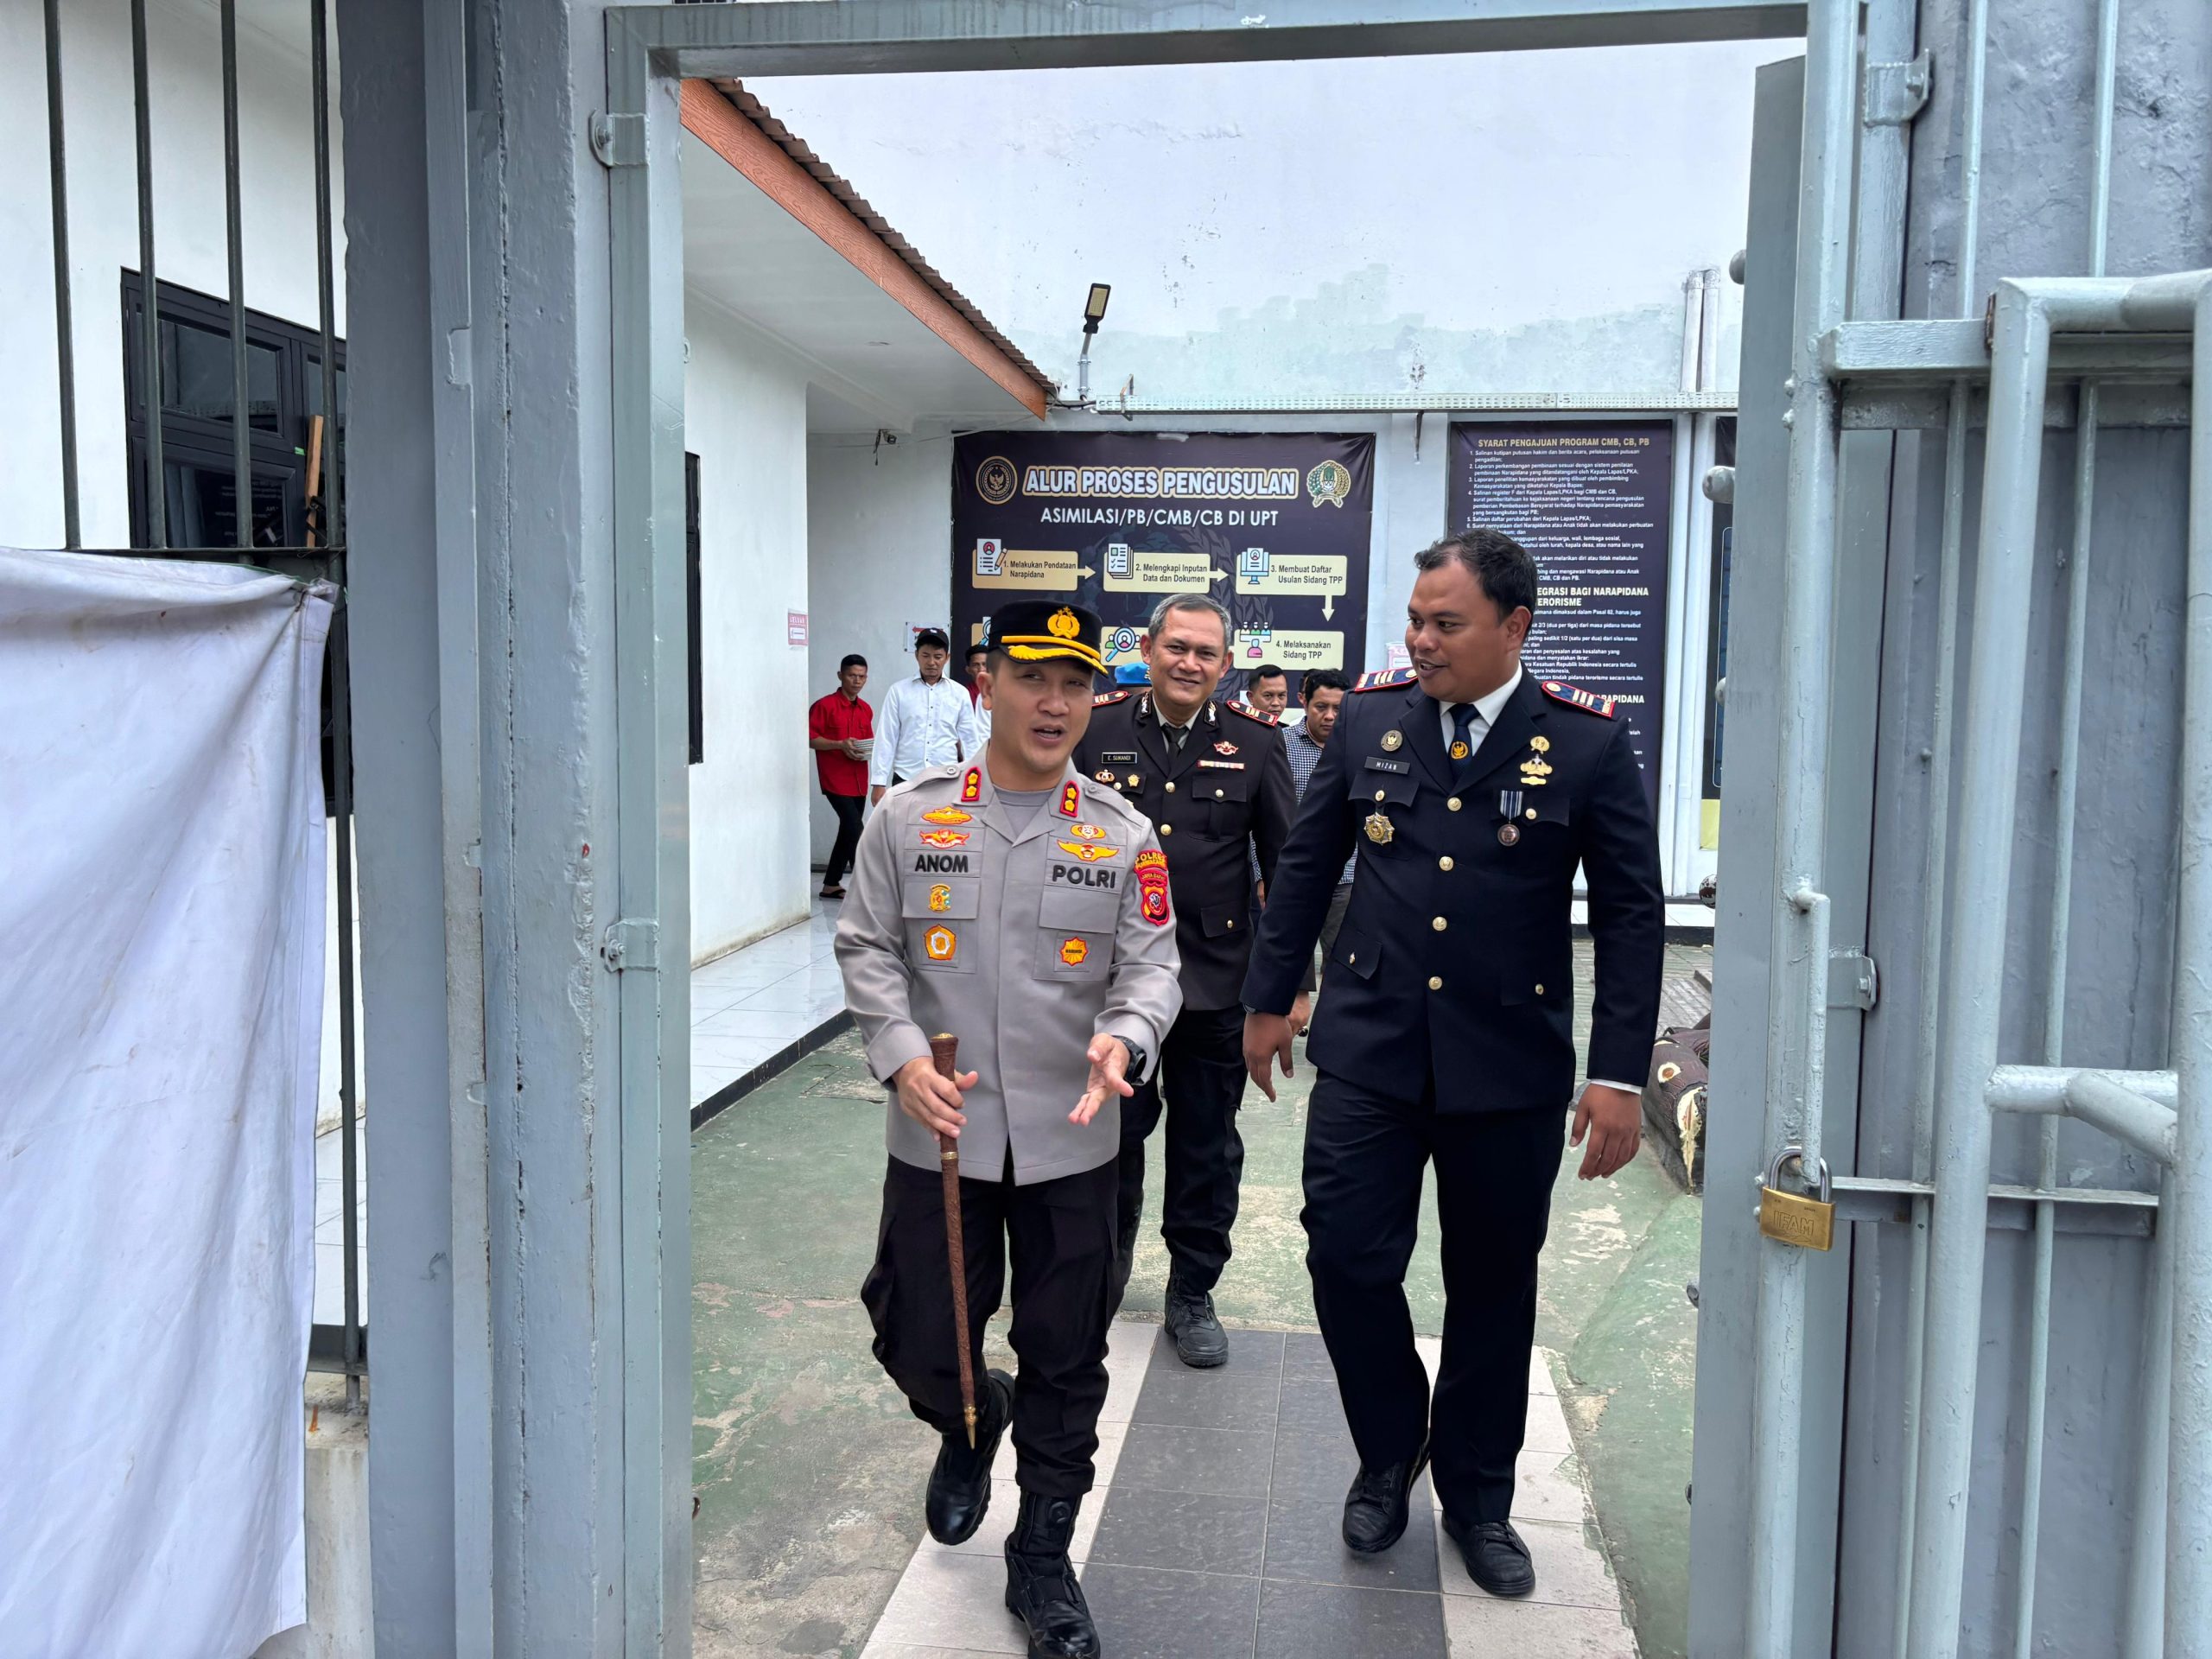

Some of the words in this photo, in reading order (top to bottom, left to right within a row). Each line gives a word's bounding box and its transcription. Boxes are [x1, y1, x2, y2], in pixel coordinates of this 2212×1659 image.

[1478, 439, 1509, 448] SYARAT
[1601, 438, 1622, 448] CMB,
[1624, 438, 1637, 447] CB,
[1026, 469, 1077, 493] ALUR
[1082, 469, 1160, 494] PROSES
[1163, 471, 1296, 495] PENGUSULAN
[1040, 507, 1223, 528] ASIMILASI/PB/CMB/CB
[1228, 511, 1245, 526] DI
[1250, 511, 1278, 526] UPT
[1044, 561, 1077, 569] Pendataan
[1143, 563, 1180, 574] Melengkapi
[1182, 564, 1207, 574] Inputan
[1270, 564, 1277, 573] 3.
[1278, 564, 1310, 573] Membuat
[1312, 565, 1332, 574] Daftar
[1009, 570, 1045, 579] Narapidana
[1303, 575, 1327, 585] Sidang
[1536, 587, 1568, 596] EGRASI
[1570, 587, 1592, 596] BAGI
[1593, 587, 1649, 596] NARAPIDANA
[1537, 597, 1582, 607] ERORISME
[1275, 639, 1282, 648] 4.
[1283, 640, 1332, 649] Melaksanakan
[1283, 651, 1306, 661] Sidang
[1308, 651, 1322, 659] TPP
[1597, 695, 1645, 703] RAPIDANA
[914, 855, 969, 873] ANOM
[1052, 865, 1116, 889] POLRI
[1773, 1210, 1815, 1236] IFAM
